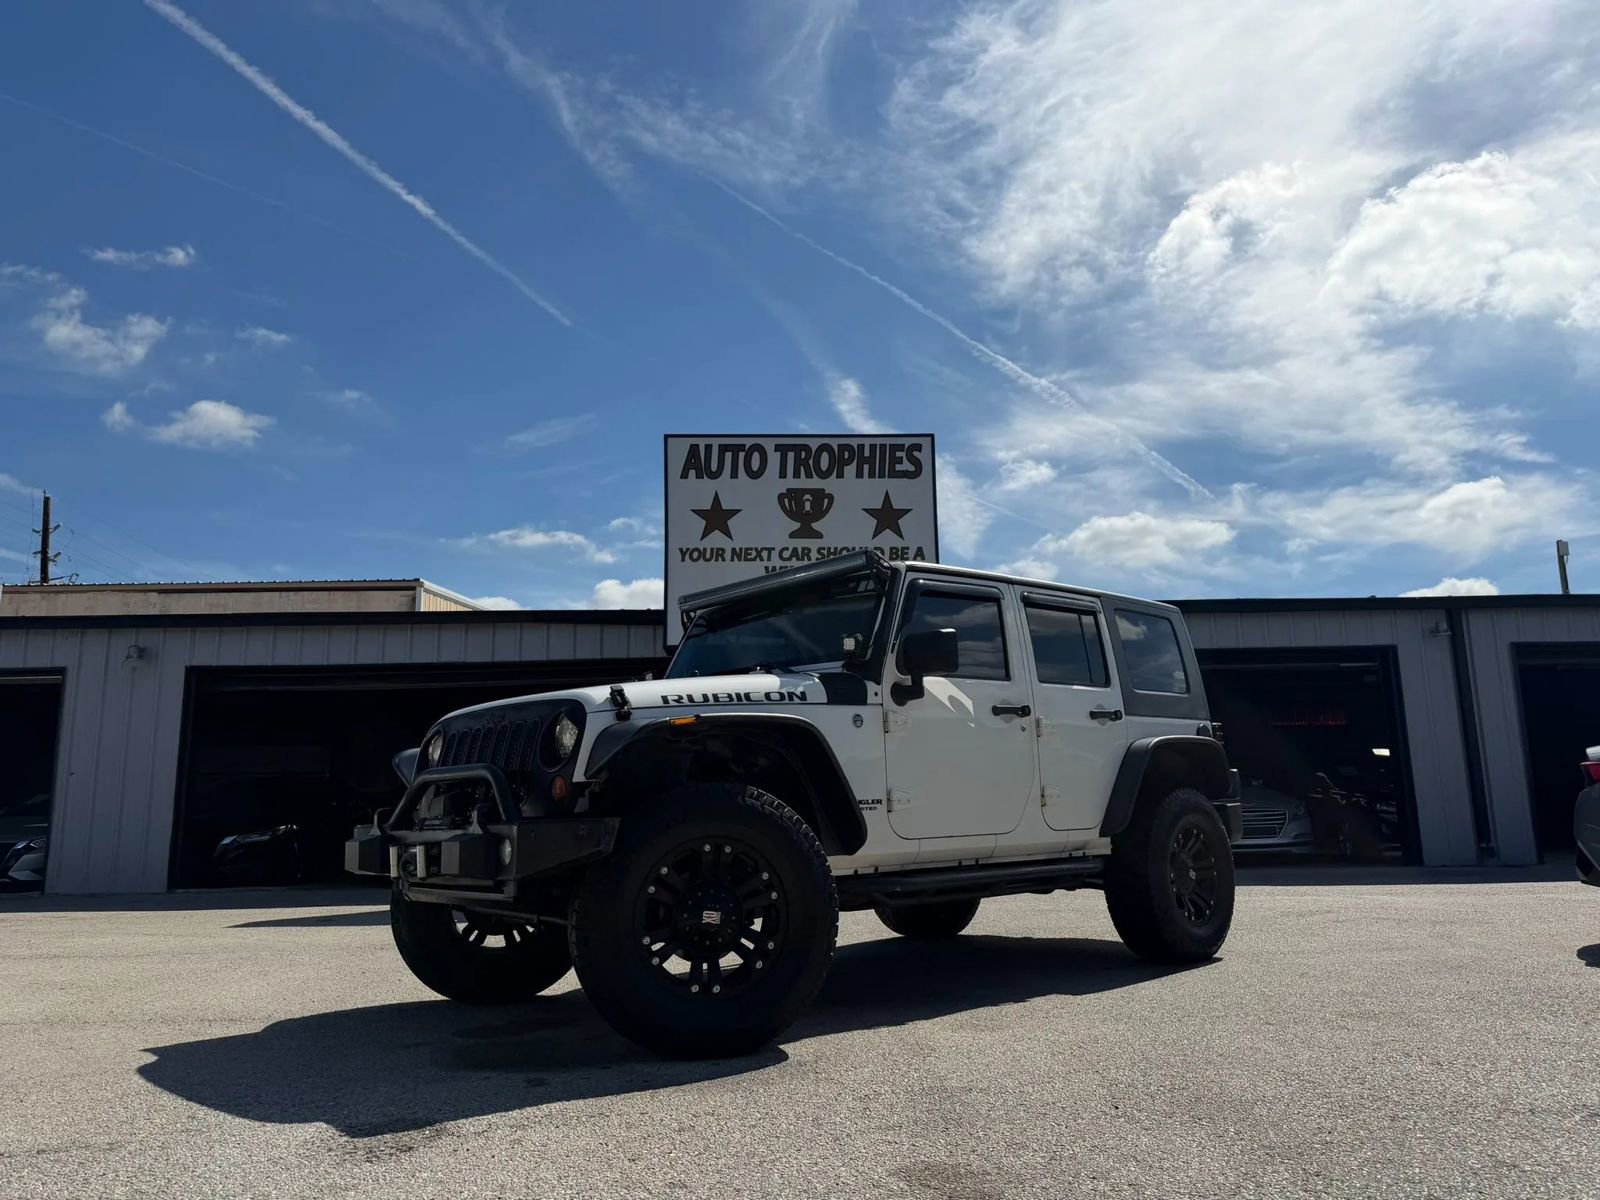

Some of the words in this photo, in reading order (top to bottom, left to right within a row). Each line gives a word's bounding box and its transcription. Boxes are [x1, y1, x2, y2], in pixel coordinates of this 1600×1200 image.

[680, 443, 768, 480] AUTO
[774, 443, 923, 480] TROPHIES
[678, 547, 726, 562] YOUR
[730, 547, 775, 562] NEXT
[778, 547, 812, 562] CAR
[816, 546, 885, 561] SHOD
[889, 546, 910, 561] BE
[912, 546, 926, 561] A
[660, 691, 807, 705] RUBICON
